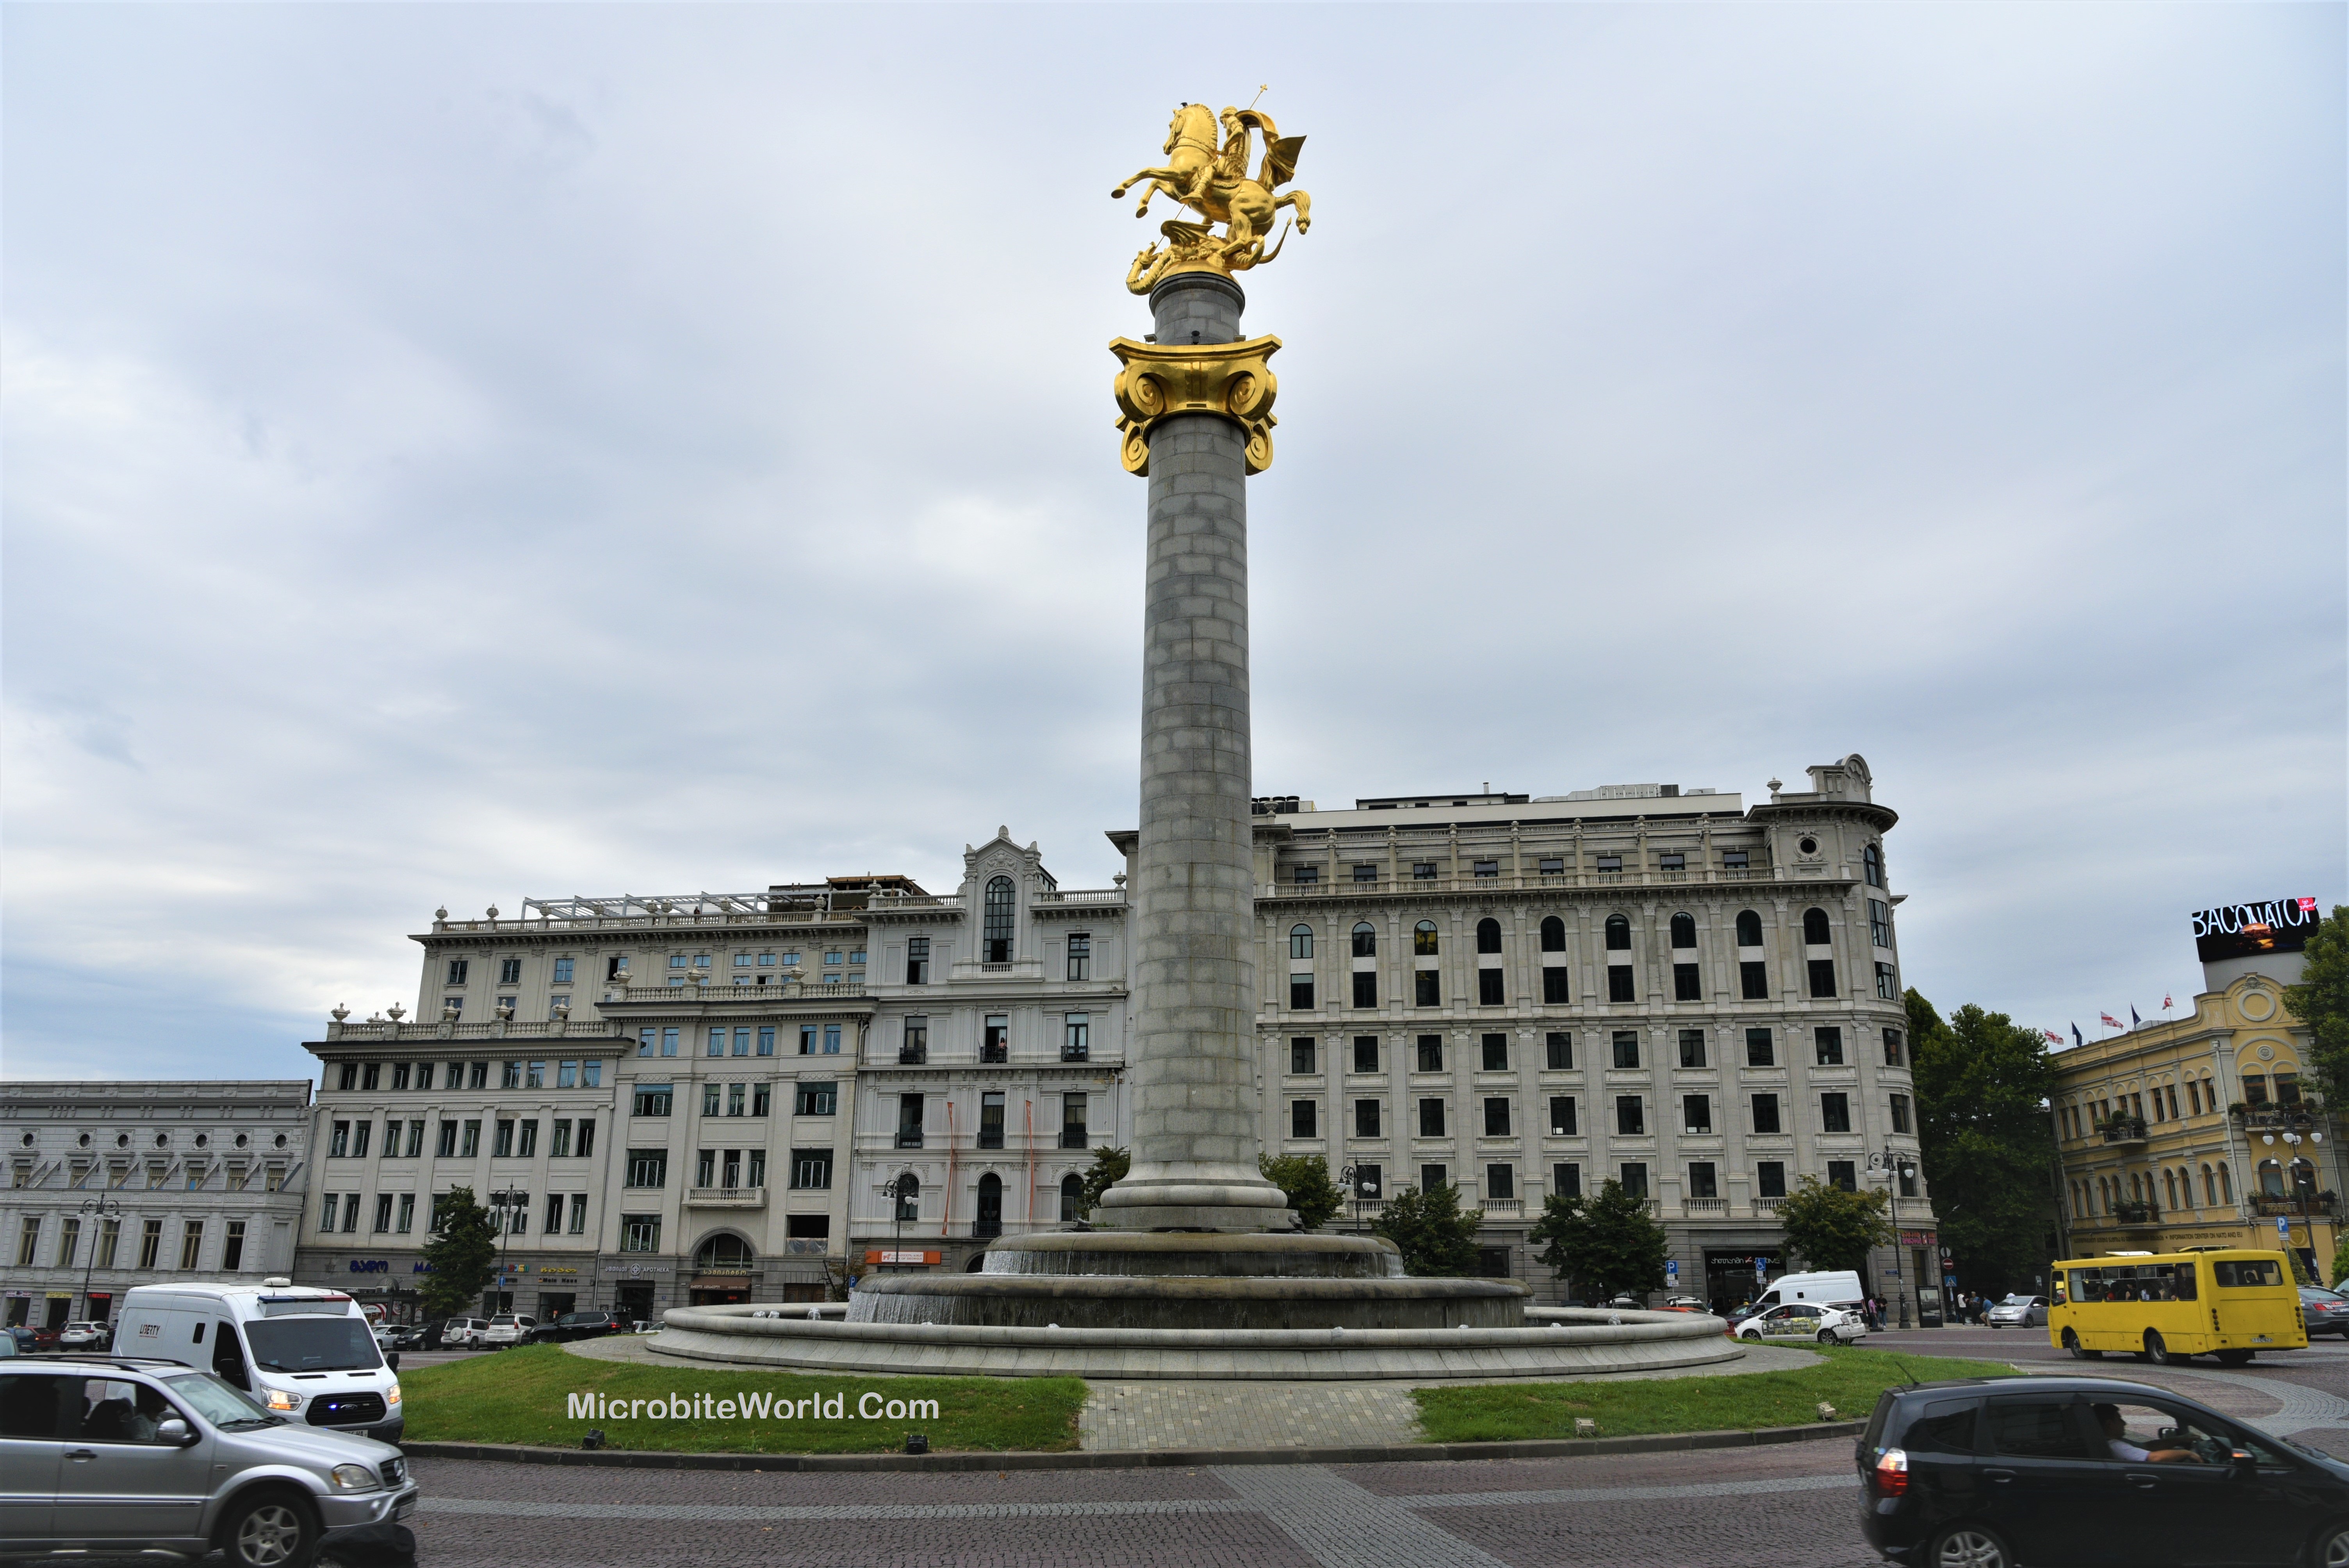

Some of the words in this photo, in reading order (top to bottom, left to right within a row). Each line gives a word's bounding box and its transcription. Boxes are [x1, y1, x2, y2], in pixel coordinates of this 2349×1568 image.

[2278, 1217, 2285, 1231] P
[1668, 1262, 1675, 1272] P
[851, 1277, 855, 1286] P
[139, 1324, 160, 1335] LIBERTY
